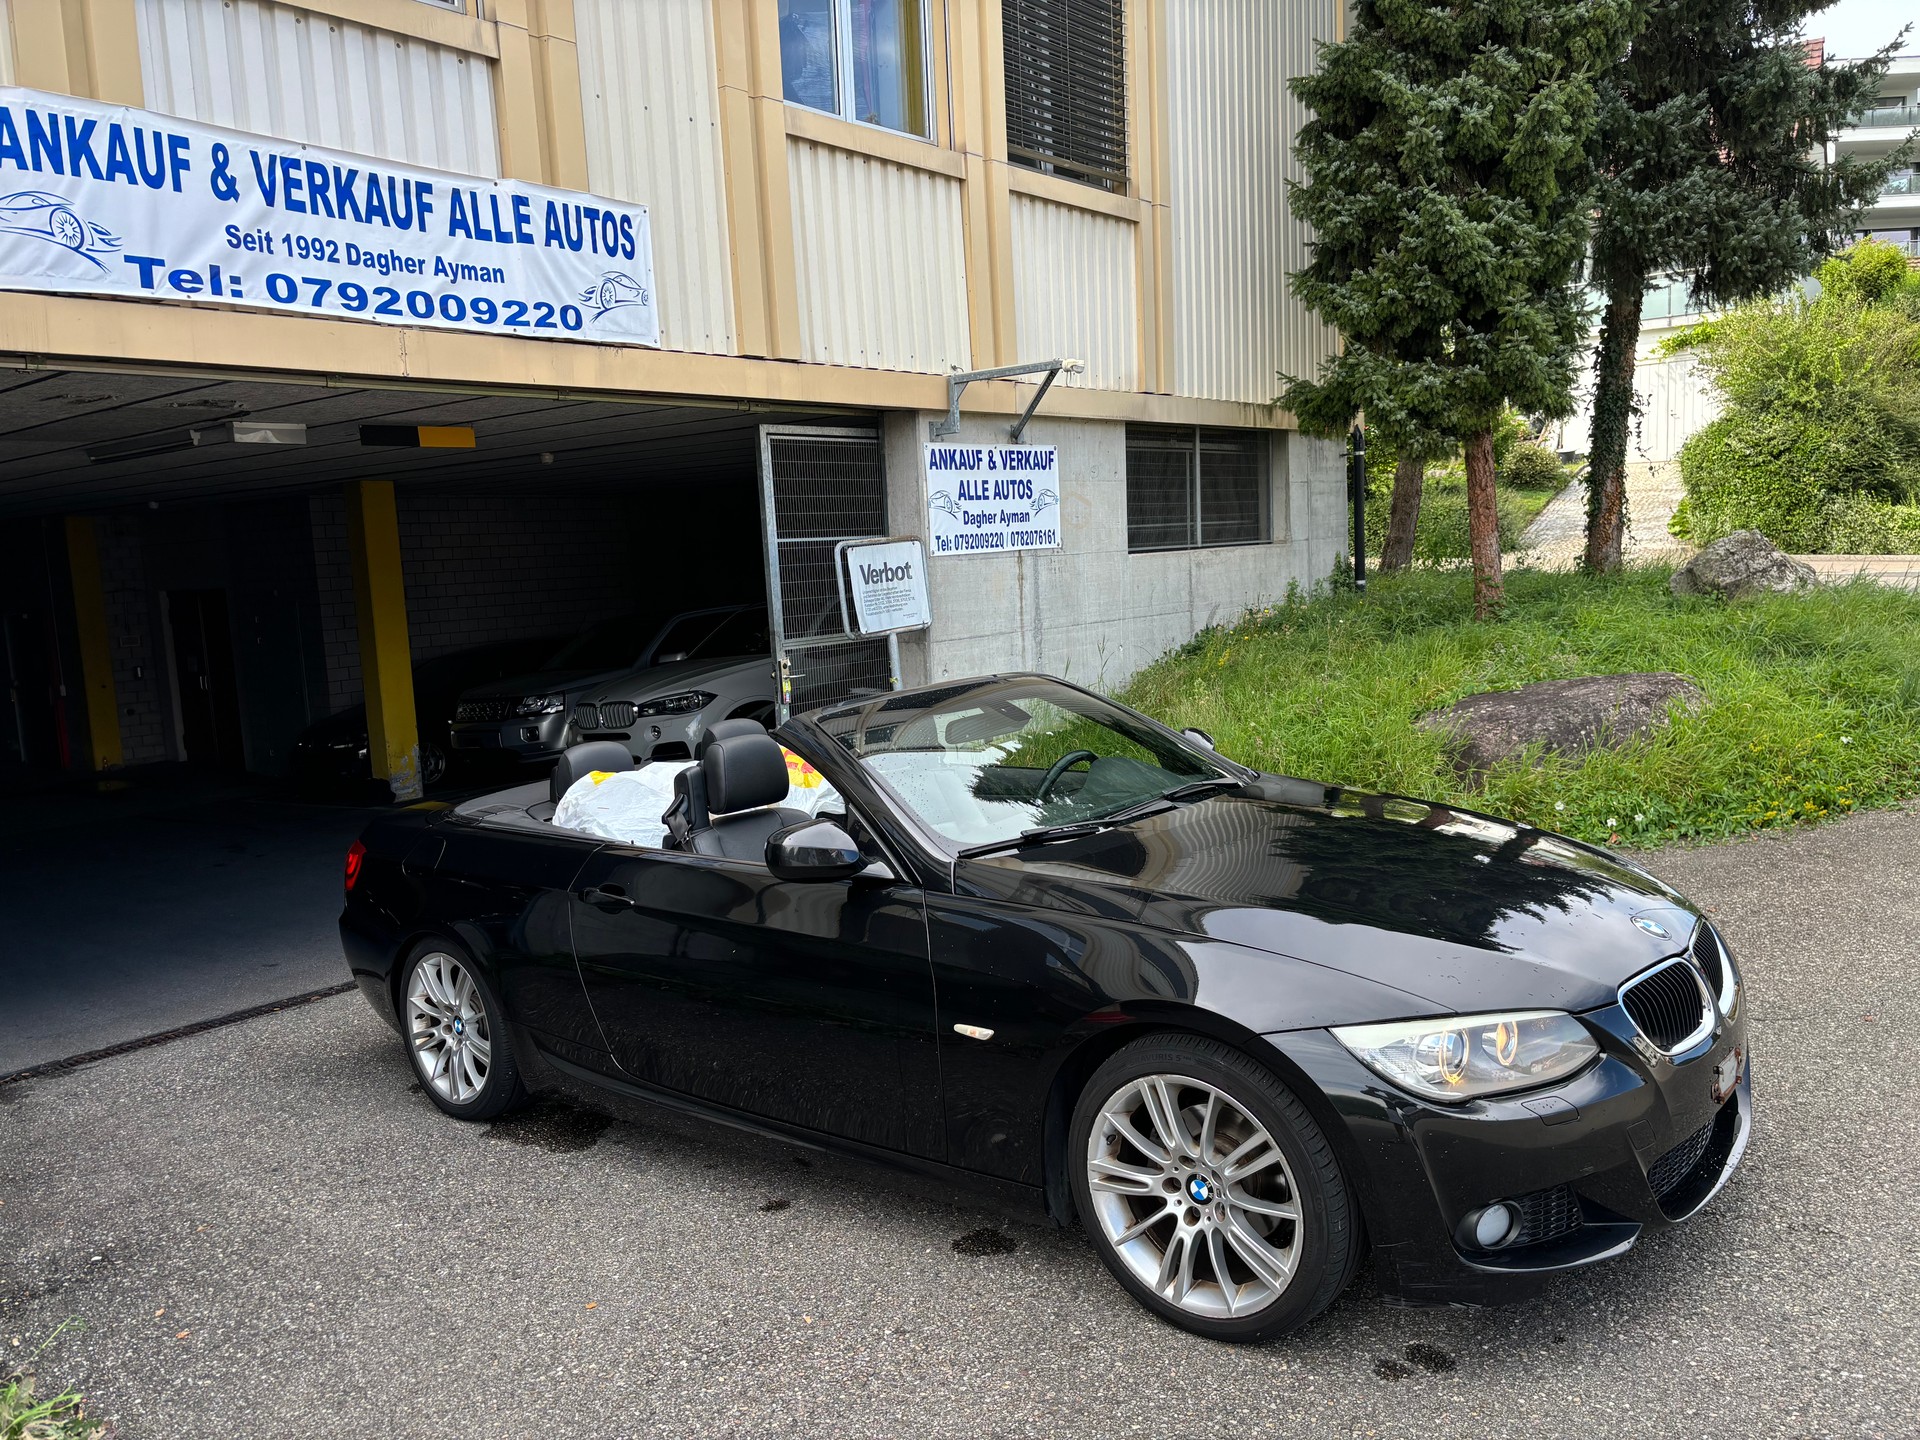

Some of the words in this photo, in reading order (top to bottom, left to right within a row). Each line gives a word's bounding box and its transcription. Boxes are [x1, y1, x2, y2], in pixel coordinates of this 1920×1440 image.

[0, 106, 191, 193] ANKAUF
[210, 142, 240, 203] &
[249, 150, 433, 233] VERKAUF
[449, 187, 535, 245] ALLE
[544, 200, 635, 261] AUTOS
[225, 224, 274, 255] Seit
[282, 233, 341, 264] 1992
[345, 242, 426, 276] Dagher
[434, 255, 505, 284] Ayman
[124, 254, 244, 298] Tel:
[265, 273, 583, 331] 0792009220
[929, 448, 983, 470] ANKAUF
[987, 449, 997, 471] &
[1000, 450, 1055, 470] VERKAUF
[958, 479, 989, 501] ALLE
[993, 479, 1033, 500] AUTOS
[963, 509, 997, 529] Dagher
[999, 509, 1030, 527] Ayman
[935, 535, 952, 552] Tel:
[954, 531, 1005, 550] 0792009220
[1010, 528, 1056, 547] 0782076161
[859, 561, 913, 585] Verbot
